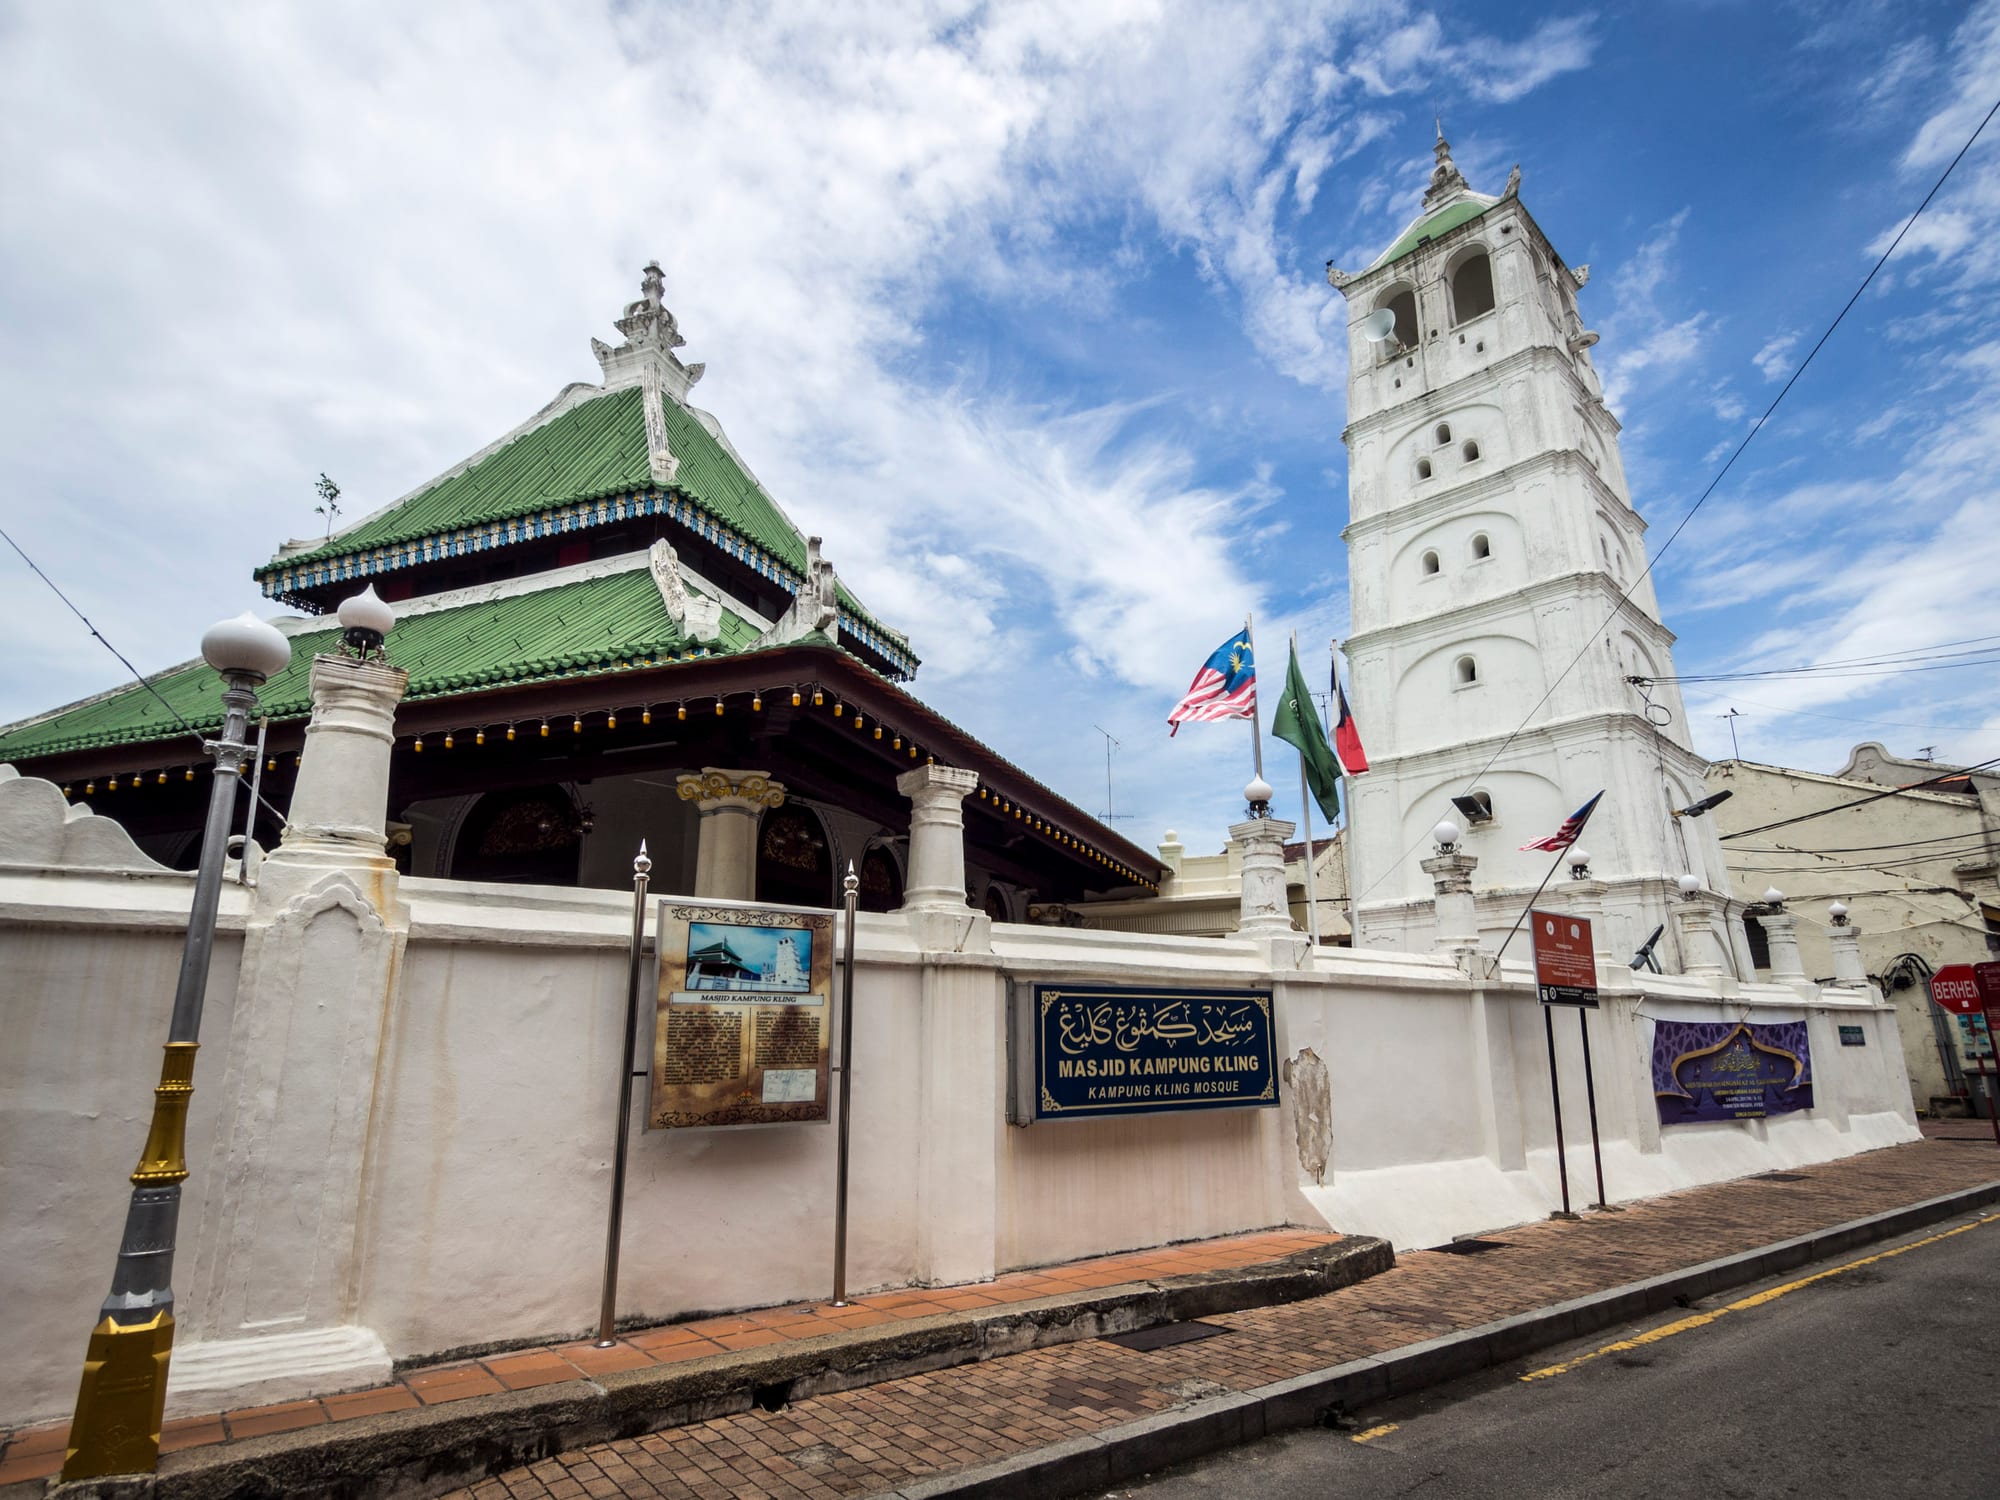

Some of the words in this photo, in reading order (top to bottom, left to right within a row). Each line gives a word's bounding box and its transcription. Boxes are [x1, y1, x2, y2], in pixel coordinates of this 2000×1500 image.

[732, 995, 771, 1003] KAMPUNG
[1934, 980, 1980, 1000] BERHEN
[1058, 1058, 1126, 1078] MASJID
[1130, 1056, 1211, 1076] KAMPUNG
[1214, 1055, 1259, 1072] KLING
[1088, 1084, 1151, 1099] KAMPUNG
[1154, 1082, 1190, 1096] KLING
[1194, 1080, 1240, 1095] MOSQUE
